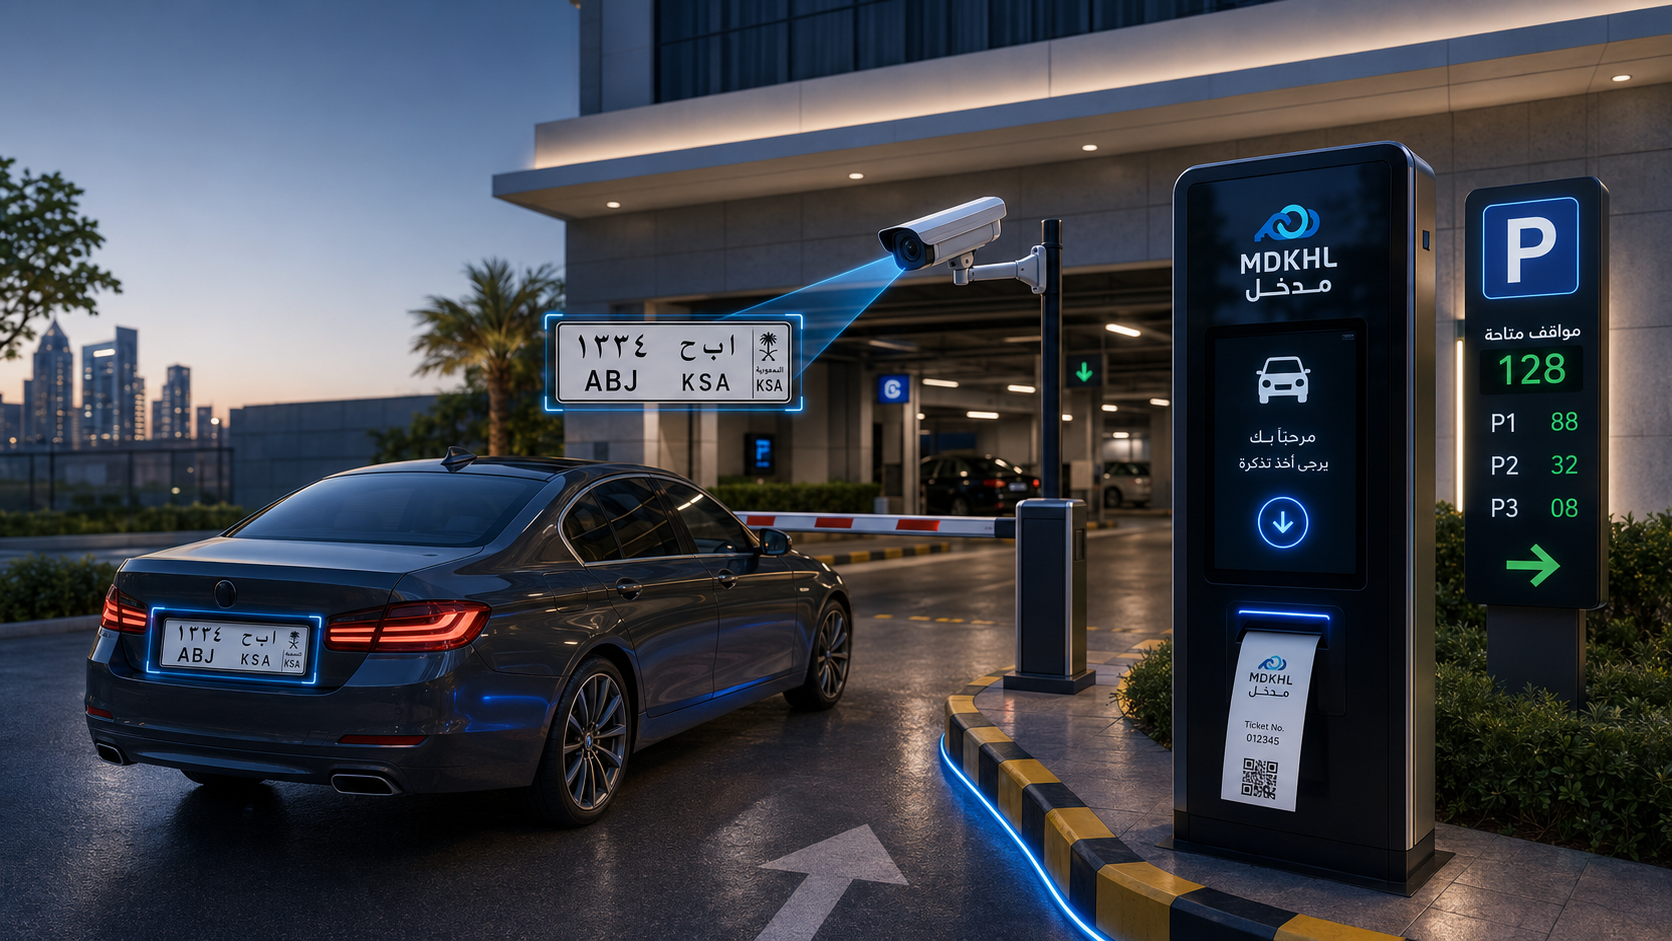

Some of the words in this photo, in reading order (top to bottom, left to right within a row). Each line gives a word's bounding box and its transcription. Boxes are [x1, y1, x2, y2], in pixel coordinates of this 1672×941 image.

[1507, 216, 1557, 283] P
[1240, 246, 1338, 275] MDKHL
[1484, 326, 1524, 342] متاحة
[1529, 324, 1581, 341] مواقف
[1499, 353, 1566, 386] 128
[1491, 412, 1516, 433] P1
[1551, 411, 1579, 432] 88
[1238, 456, 1272, 472] تذكرة
[1274, 454, 1295, 469] أخذ
[1297, 461, 1329, 472] يرجى
[1491, 455, 1519, 476] P2
[1551, 455, 1579, 475] 32
[1491, 498, 1519, 518] P3
[1551, 498, 1579, 518] 08
[177, 647, 214, 664] ABJ
[240, 653, 271, 667] KSA
[284, 659, 300, 668] KSA
[1249, 672, 1293, 685] MDKHL
[1244, 720, 1269, 731] Ticket
[1270, 723, 1285, 732] No.
[1246, 733, 1280, 746] 012345
